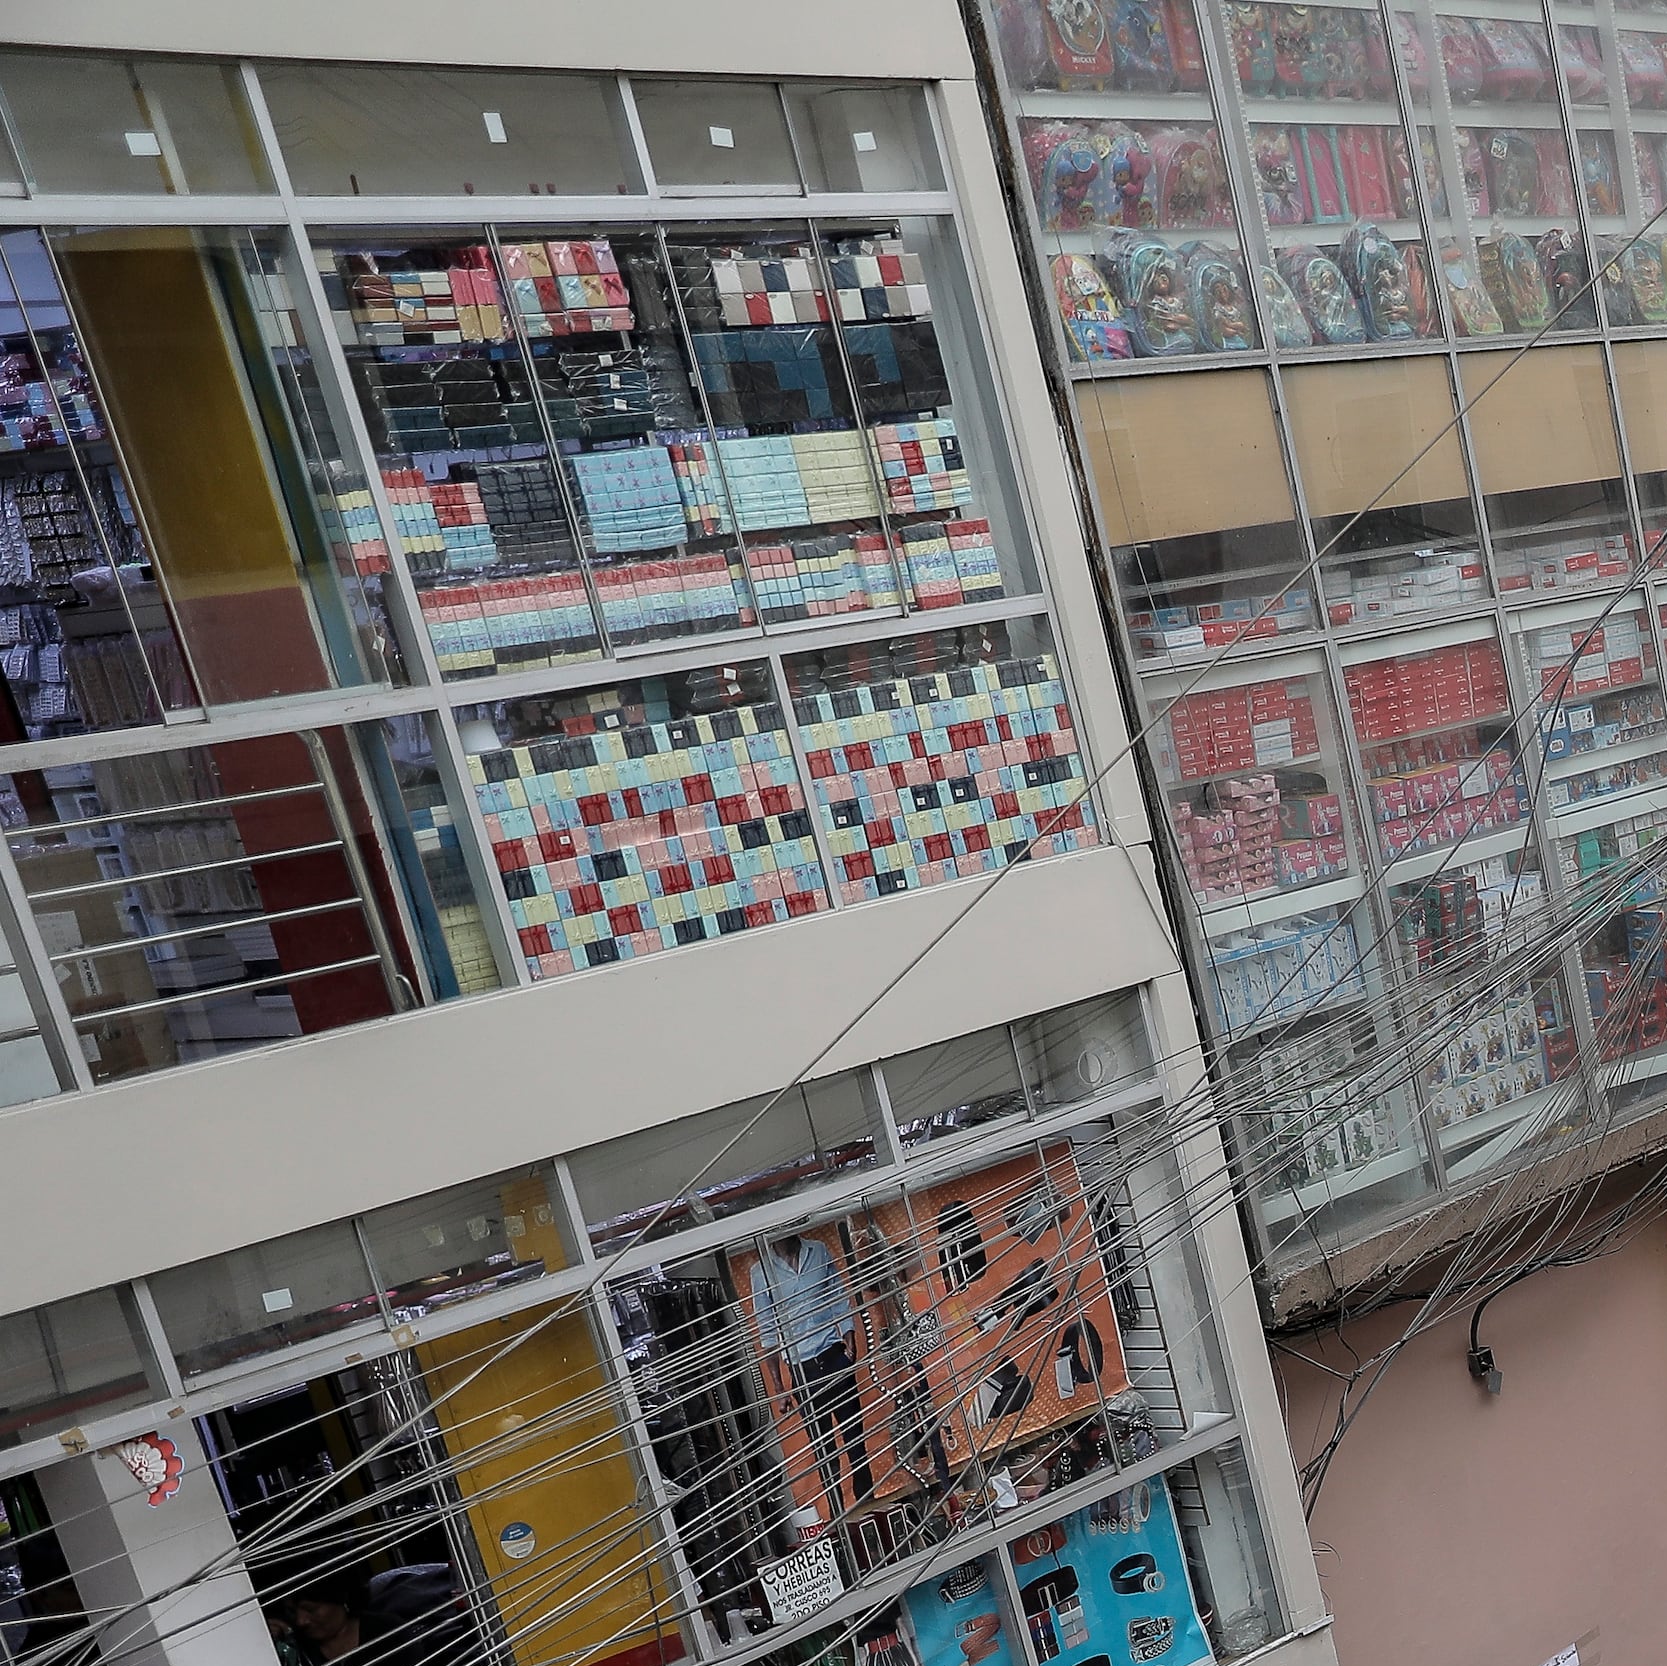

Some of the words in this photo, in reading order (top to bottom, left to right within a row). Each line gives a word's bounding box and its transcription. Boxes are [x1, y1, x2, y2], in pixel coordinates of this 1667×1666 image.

[762, 1542, 832, 1585] CORREAS
[773, 1584, 782, 1596] Y
[783, 1562, 830, 1593] HEBILLAS
[773, 1596, 787, 1609] NOS
[787, 1577, 832, 1602] TRASLADAMOS
[832, 1574, 837, 1582] A
[785, 1602, 794, 1612] JR.
[794, 1592, 817, 1609] CUSCO
[812, 1597, 830, 1611] PISO
